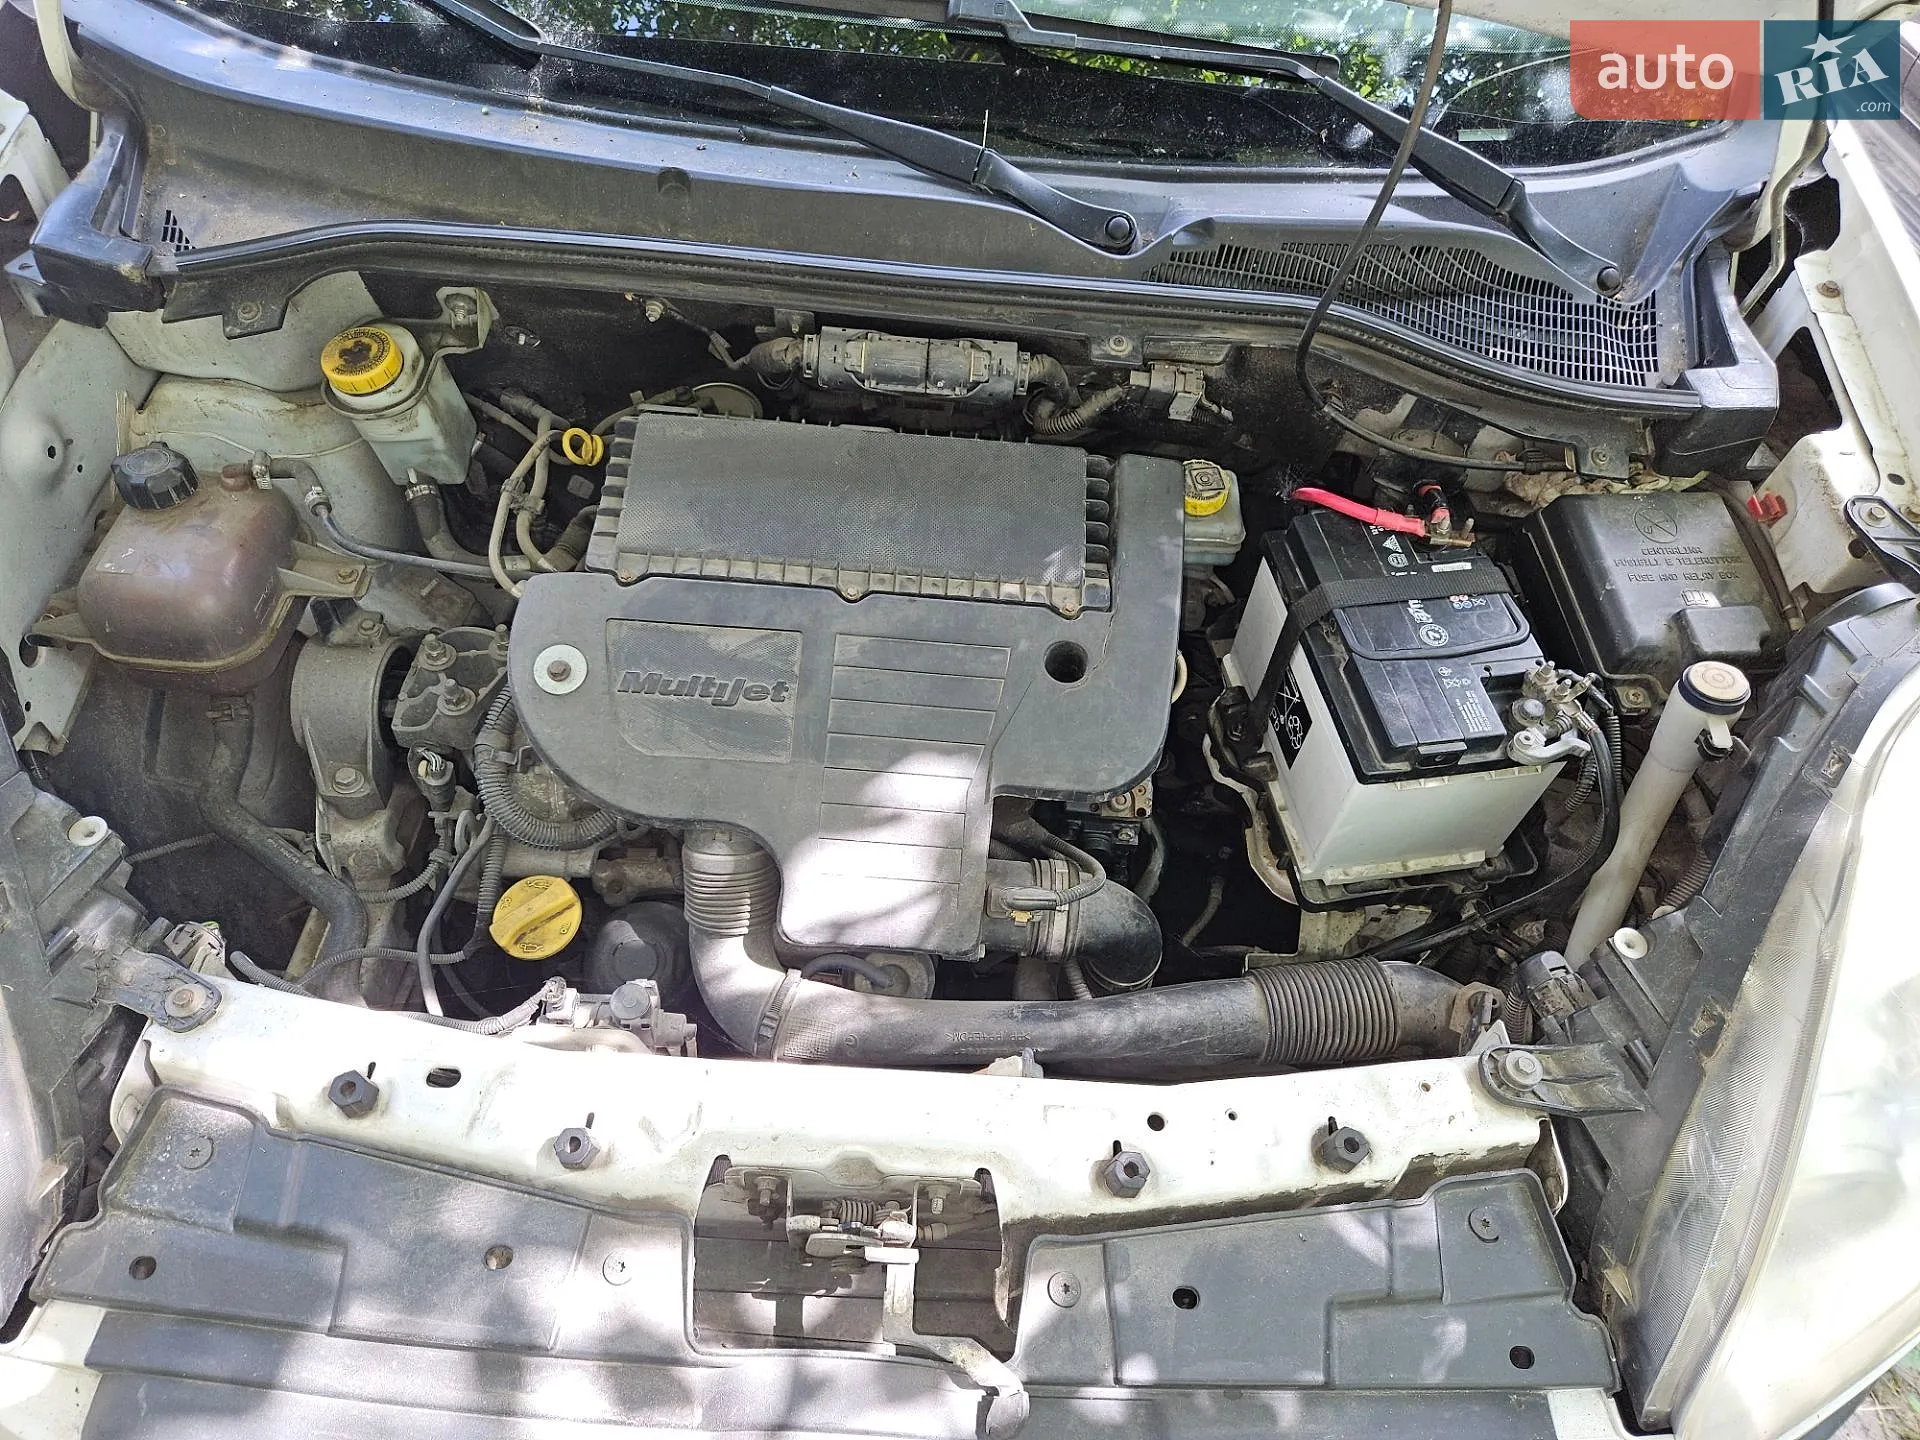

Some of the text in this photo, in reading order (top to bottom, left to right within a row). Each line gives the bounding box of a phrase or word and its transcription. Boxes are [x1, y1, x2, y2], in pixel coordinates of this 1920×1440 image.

[1627, 571, 1741, 582] FUSE AND RELAY BOX
[616, 670, 790, 708] MultiJet
